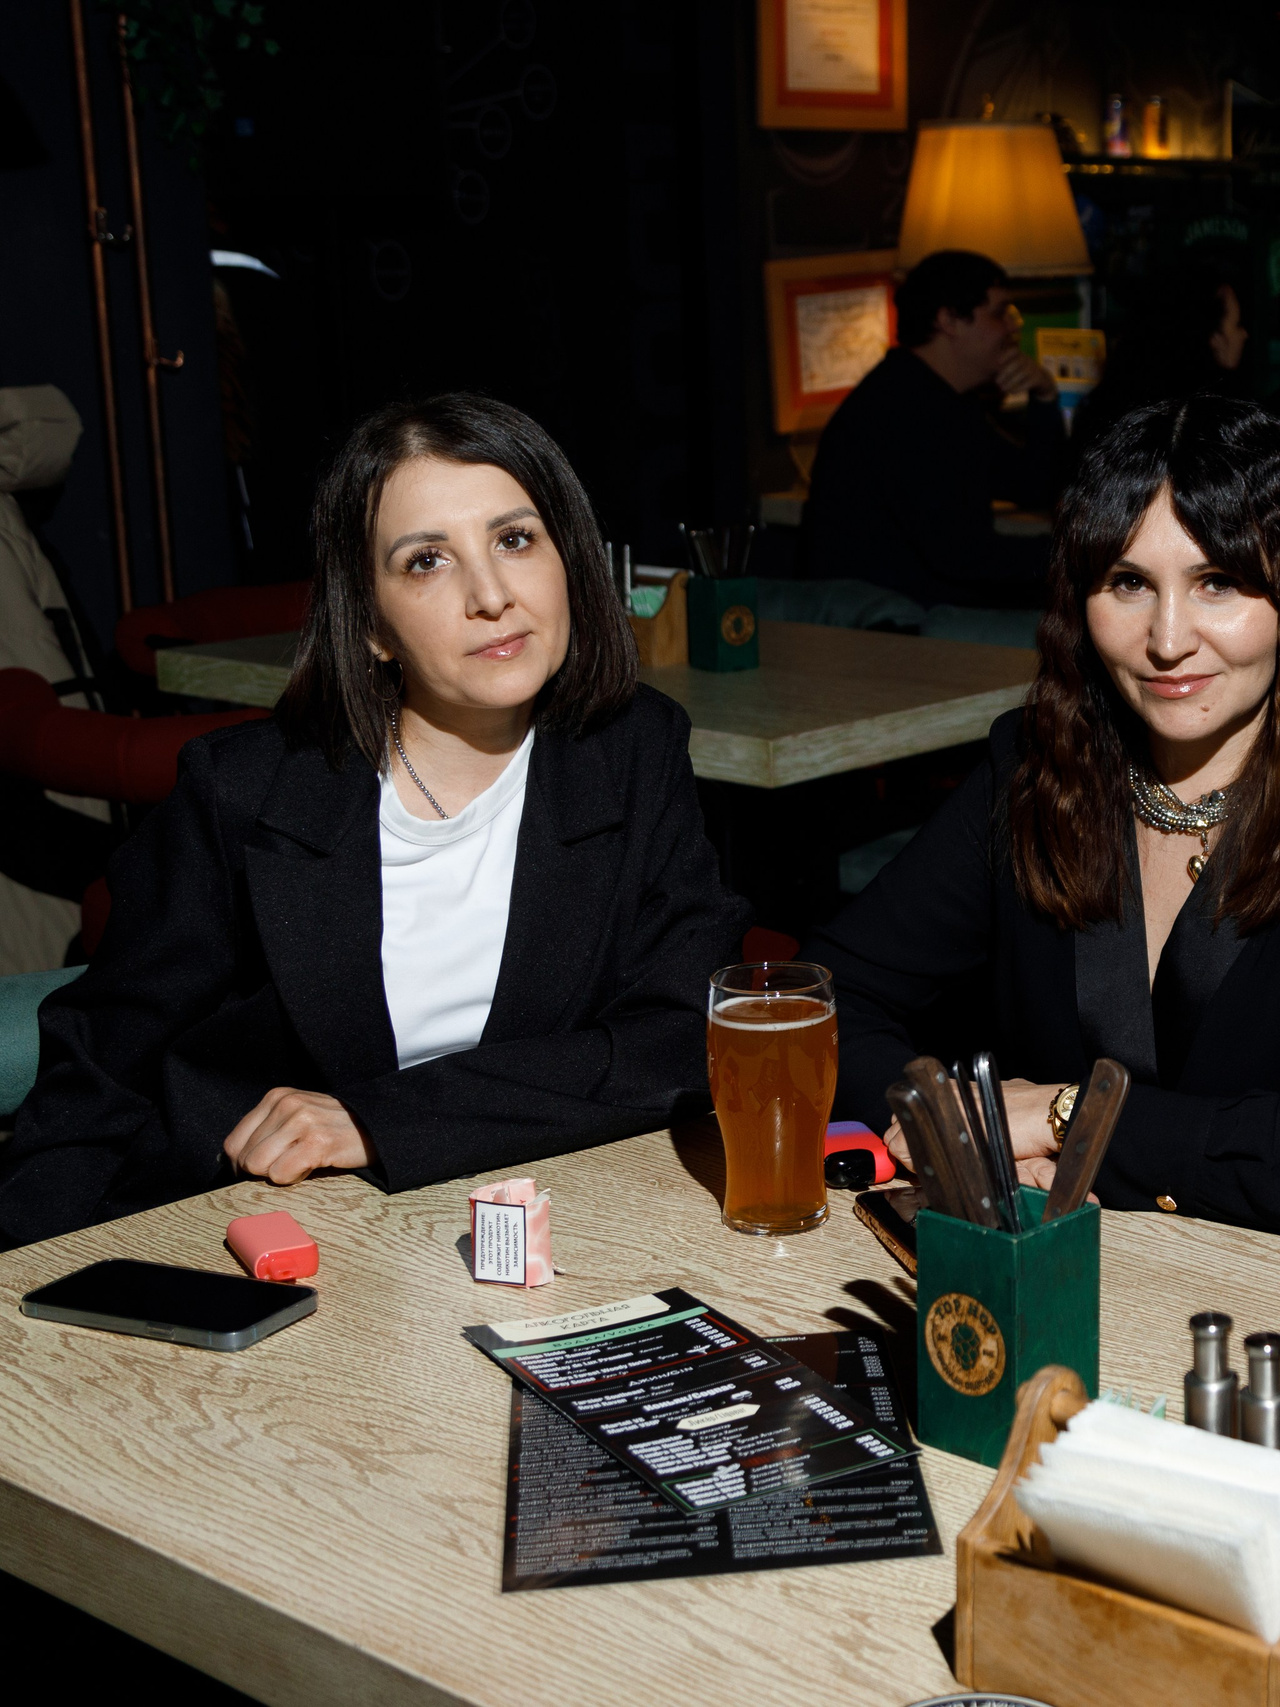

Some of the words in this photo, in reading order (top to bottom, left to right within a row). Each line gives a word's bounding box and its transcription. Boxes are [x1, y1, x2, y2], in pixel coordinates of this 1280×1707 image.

[525, 1304, 629, 1327] АЛКОГОЛЬНАЯ
[935, 1298, 961, 1320] TOP
[967, 1302, 998, 1336] HOP
[560, 1317, 607, 1329] КАРТА
[565, 1349, 600, 1358] Samogon
[598, 1352, 633, 1362] Premium
[527, 1362, 556, 1371] Absolut
[544, 1375, 573, 1383] Tundra
[573, 1370, 600, 1378] Forest
[600, 1364, 627, 1373] Woody
[628, 1358, 651, 1366] Notes
[538, 1372, 559, 1380] Altay
[629, 1367, 692, 1386] ДЖИН/GIN
[644, 1384, 734, 1410] Коньяк/Cognac
[577, 1402, 601, 1410] Royal
[601, 1420, 632, 1430] Martell
[607, 1424, 638, 1434] Martell
